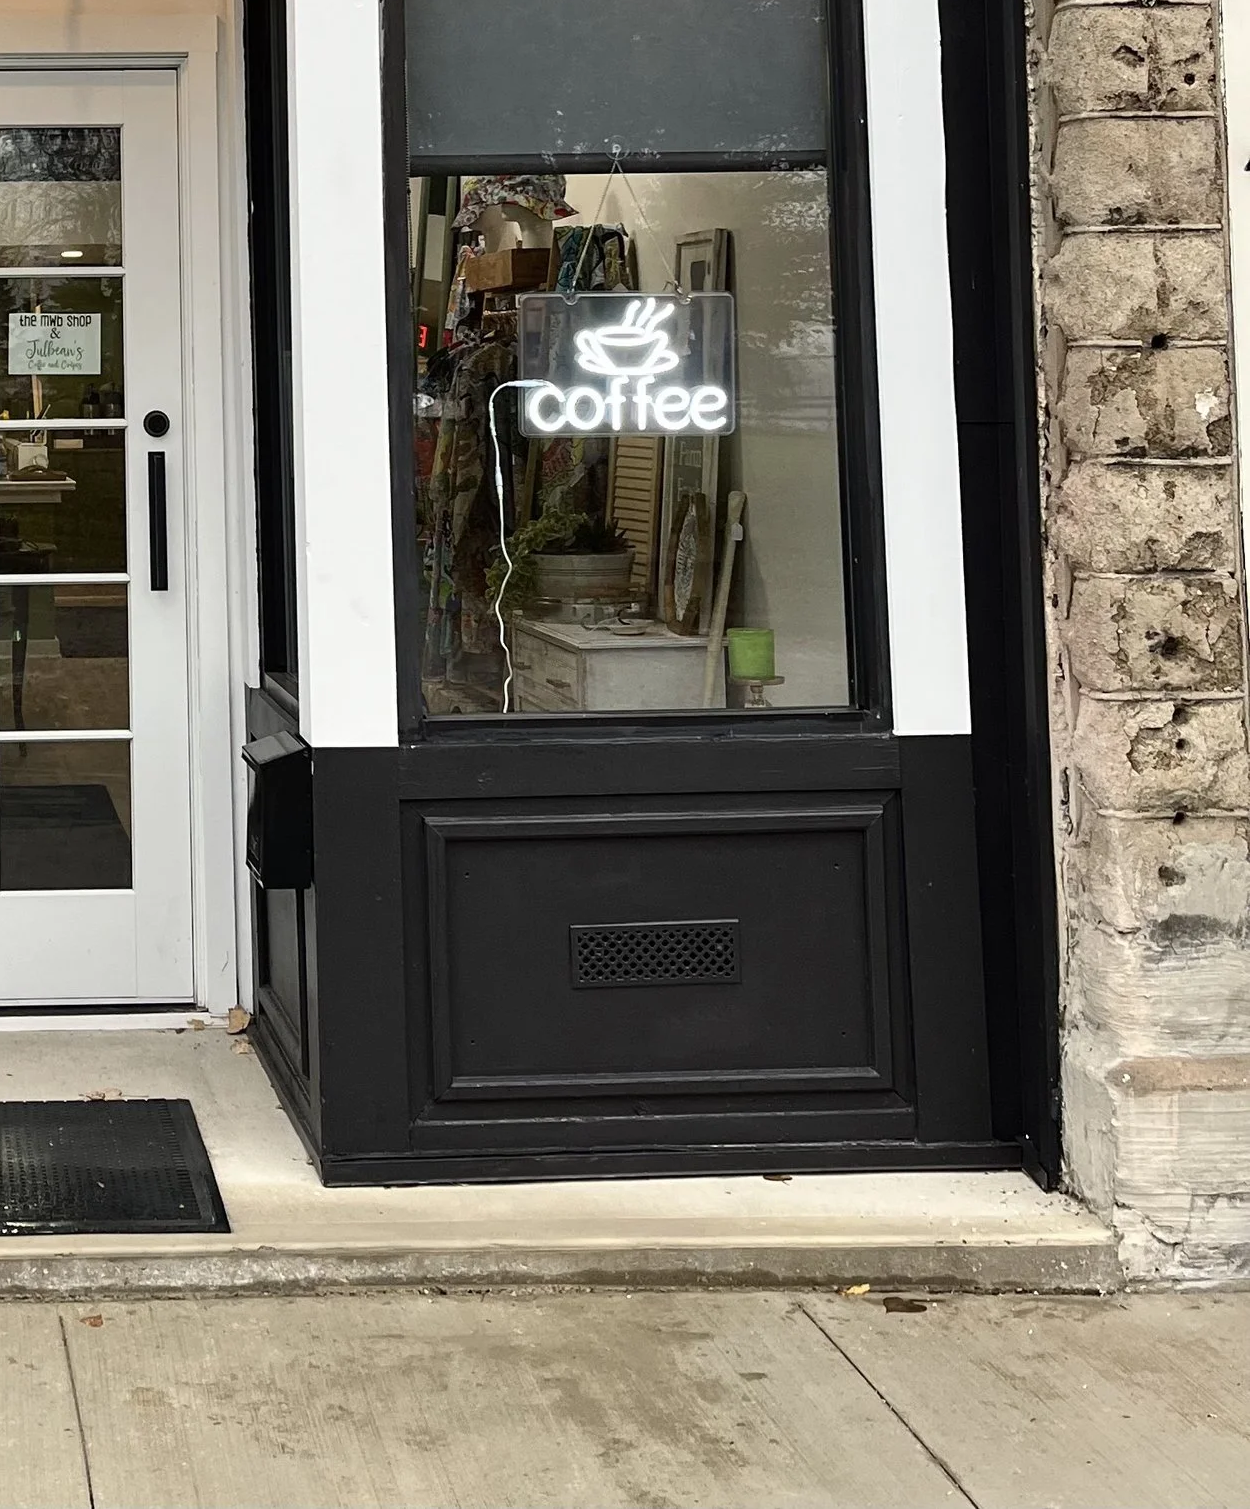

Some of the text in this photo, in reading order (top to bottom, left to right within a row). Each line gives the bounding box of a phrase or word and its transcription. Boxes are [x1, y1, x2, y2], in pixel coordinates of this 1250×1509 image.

[19, 315, 92, 327] the mwb shop
[50, 327, 61, 339] &
[526, 374, 728, 432] coffee
